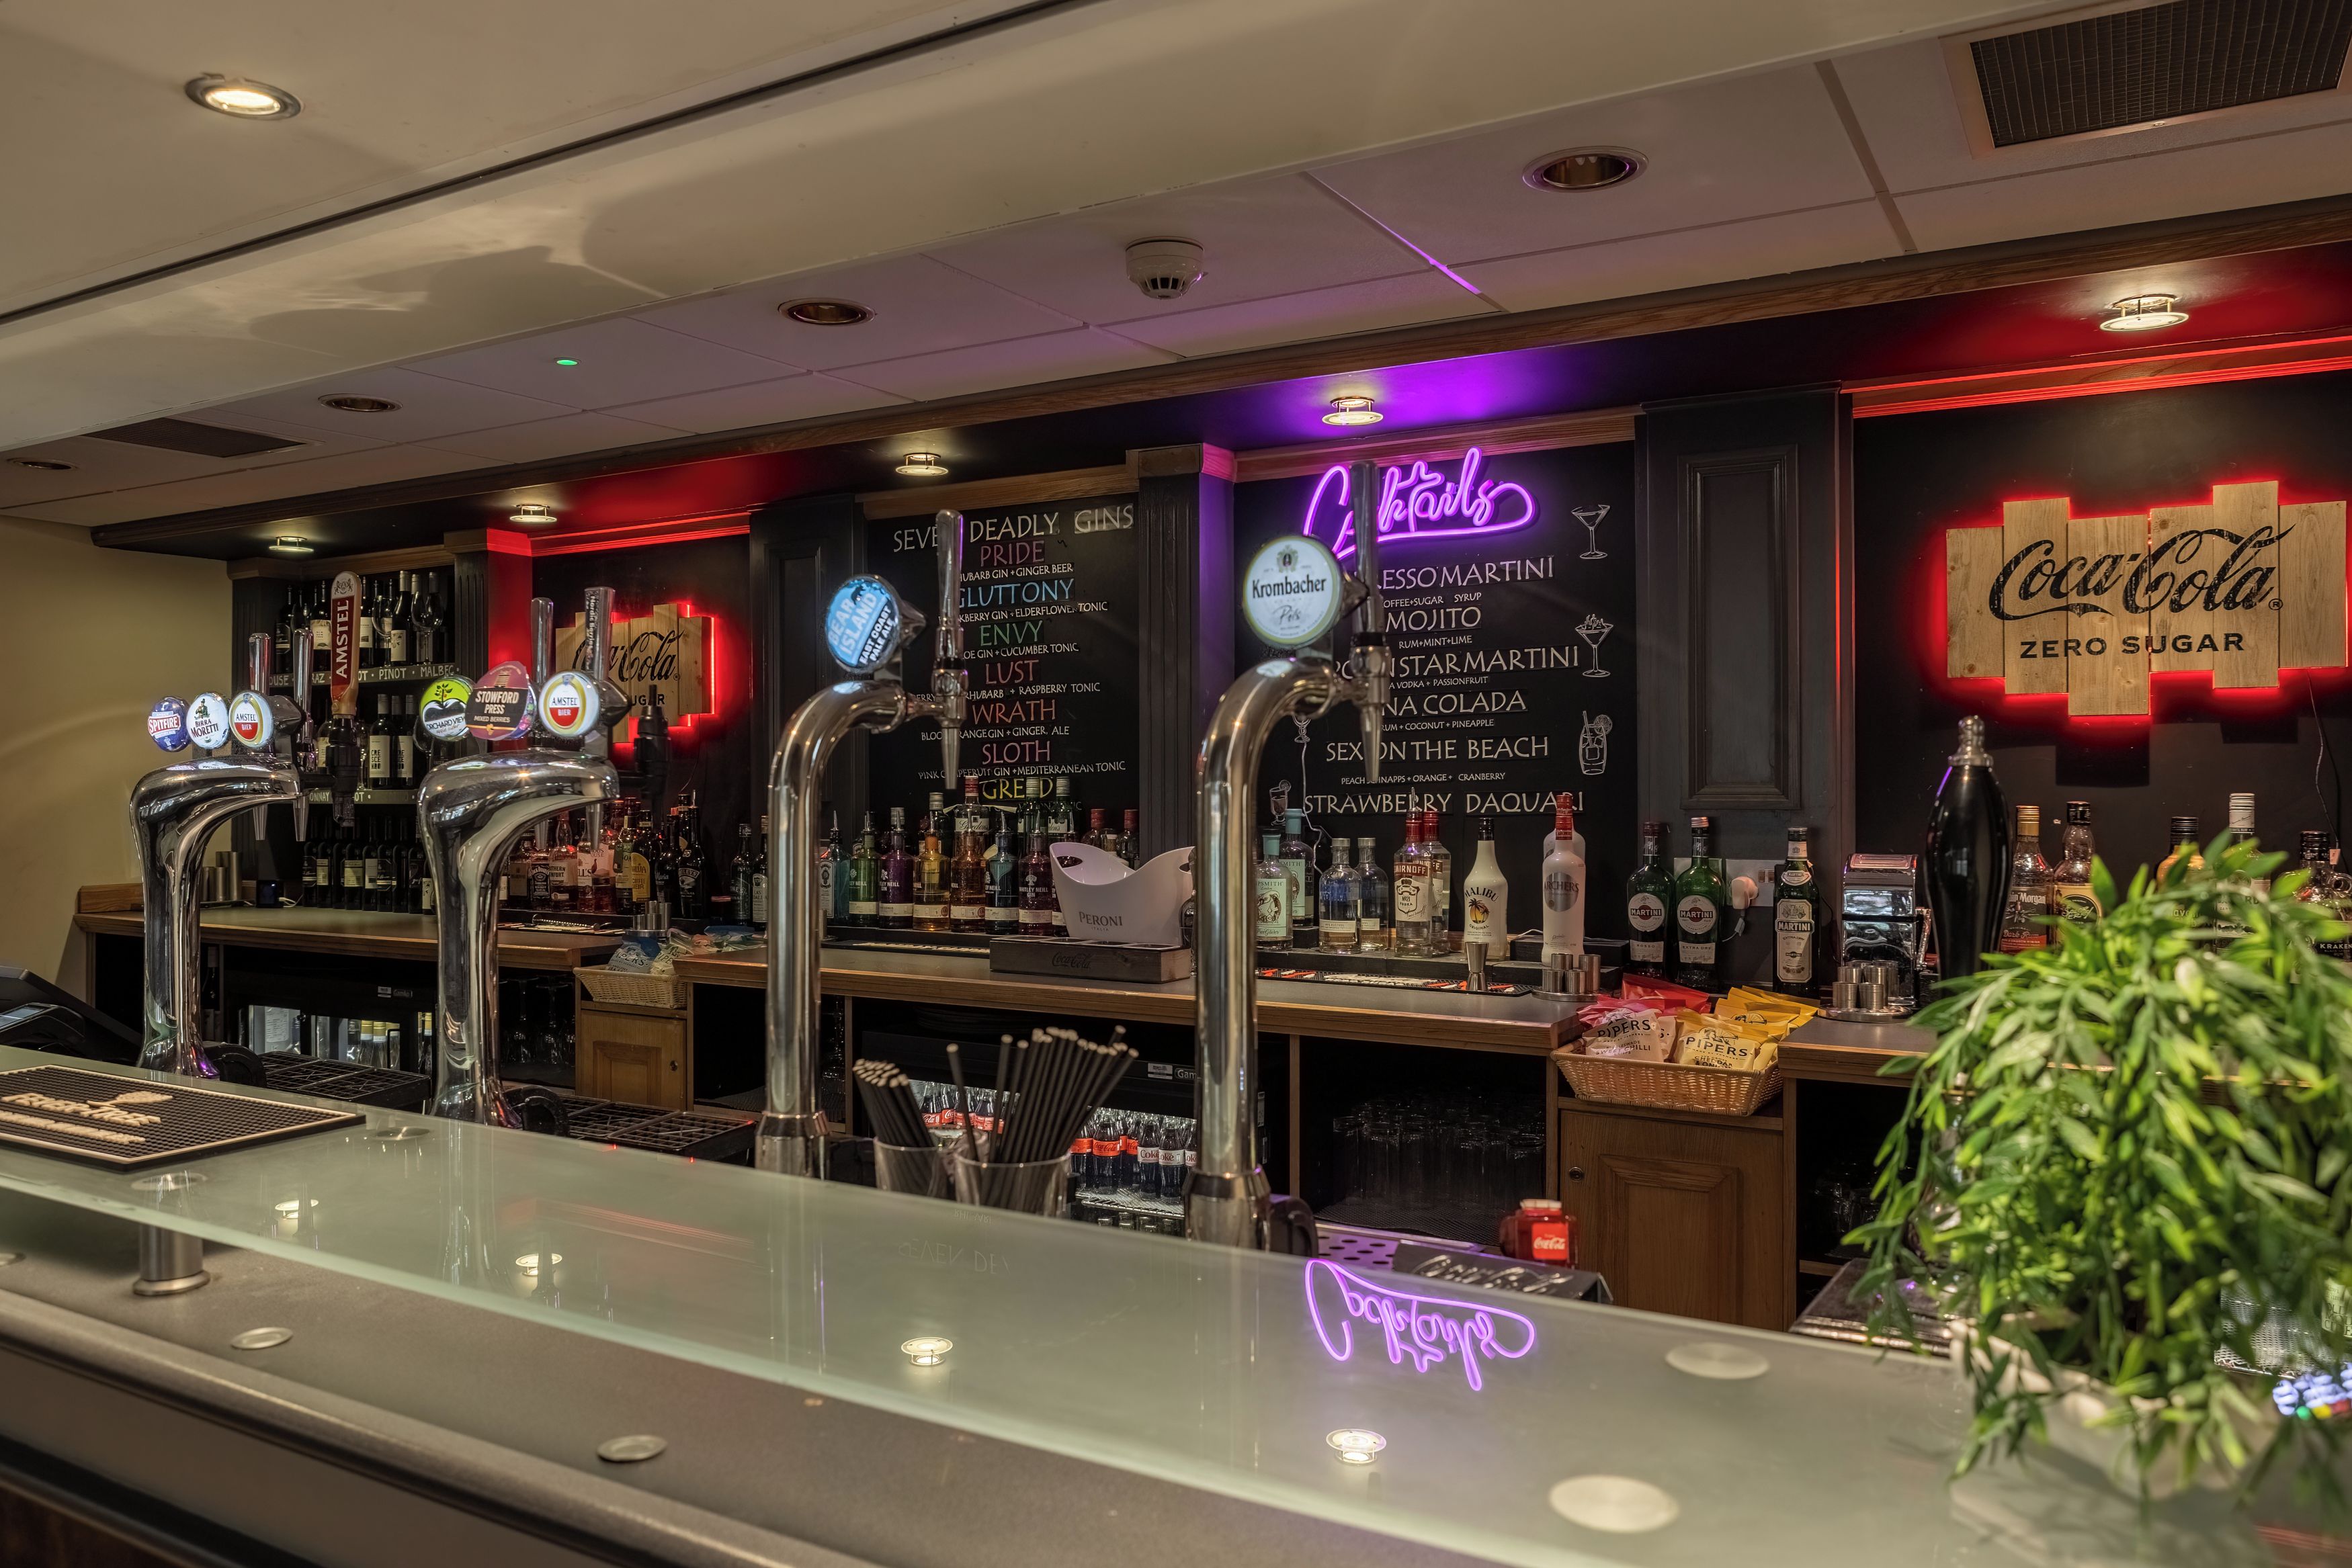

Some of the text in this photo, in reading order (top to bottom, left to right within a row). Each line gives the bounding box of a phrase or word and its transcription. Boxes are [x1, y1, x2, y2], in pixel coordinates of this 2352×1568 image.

[1303, 446, 1536, 560] Cktails
[893, 504, 1135, 552] SEVE DEADLY GINS
[980, 540, 1045, 567] PRIDE
[992, 568, 1008, 579] GIN
[1052, 563, 1073, 574] BEER
[1441, 555, 1554, 588] MARTINI
[1988, 523, 2296, 621] Coca-Cola
[1252, 574, 1327, 599] Krombacher
[1454, 592, 1482, 604] SYRUP
[991, 609, 1008, 621] GIN
[1077, 601, 1108, 612] TONIC
[838, 593, 878, 655] ISLAND
[1385, 606, 1482, 634] MOJITO
[335, 599, 349, 679] AMSTEL
[980, 619, 1044, 646] ENVY
[977, 648, 994, 659] GIN
[1000, 643, 1050, 658] CUCUMBER
[1050, 642, 1080, 653] TONIC
[2020, 632, 2244, 660] ZERO SUGAR
[1463, 646, 1579, 673] MARTINI
[378, 667, 407, 681] PINOT
[419, 664, 454, 679] MALBEC
[985, 660, 1040, 685] LUST
[1019, 683, 1067, 696] RASPBERRY
[1070, 682, 1101, 694] TONIC
[1396, 679, 1425, 689] VODKA
[1433, 674, 1489, 687] PASSIONFRUIT
[475, 691, 520, 704] STOWFORD
[1422, 690, 1527, 717] COLADA
[236, 713, 256, 722] AMSTEL
[484, 703, 505, 715] PRESS
[557, 709, 572, 717] BIER
[972, 699, 1057, 726] WRATH
[148, 715, 180, 733] SPITFIRE
[195, 718, 212, 727] BIRRA
[241, 723, 253, 731] BIER
[489, 715, 511, 724] BERRIES
[1404, 720, 1445, 731] COCONUT
[1452, 718, 1495, 729] PINEAPPLE
[191, 723, 219, 738] MORETTI
[1051, 725, 1070, 736] ALE
[982, 740, 1051, 765] SLOTH
[1326, 741, 1364, 762] SEX
[1411, 740, 1457, 760] THE
[1468, 736, 1549, 759] BEACH
[918, 769, 940, 780] PINK
[994, 767, 1009, 777] GIN
[1095, 761, 1126, 773] TONIC
[1341, 777, 1365, 785] PEACH
[1413, 773, 1447, 783] ORANGE
[1458, 772, 1506, 782] CRANBERRY
[980, 777, 1054, 799] GRED
[1303, 792, 1453, 814] STRAWBERRY
[1465, 886, 1500, 902] MALIBU
[1544, 881, 1579, 893] ARCHERS
[2019, 892, 2047, 905] Morgan
[1079, 911, 1123, 927] PERONI
[1630, 908, 1662, 916] MARTINI
[1680, 910, 1713, 918] MARTINI
[1777, 921, 1811, 931] MARTINI
[1597, 1019, 1651, 1039] PIPERS
[1685, 1037, 1749, 1057] PIPERS
